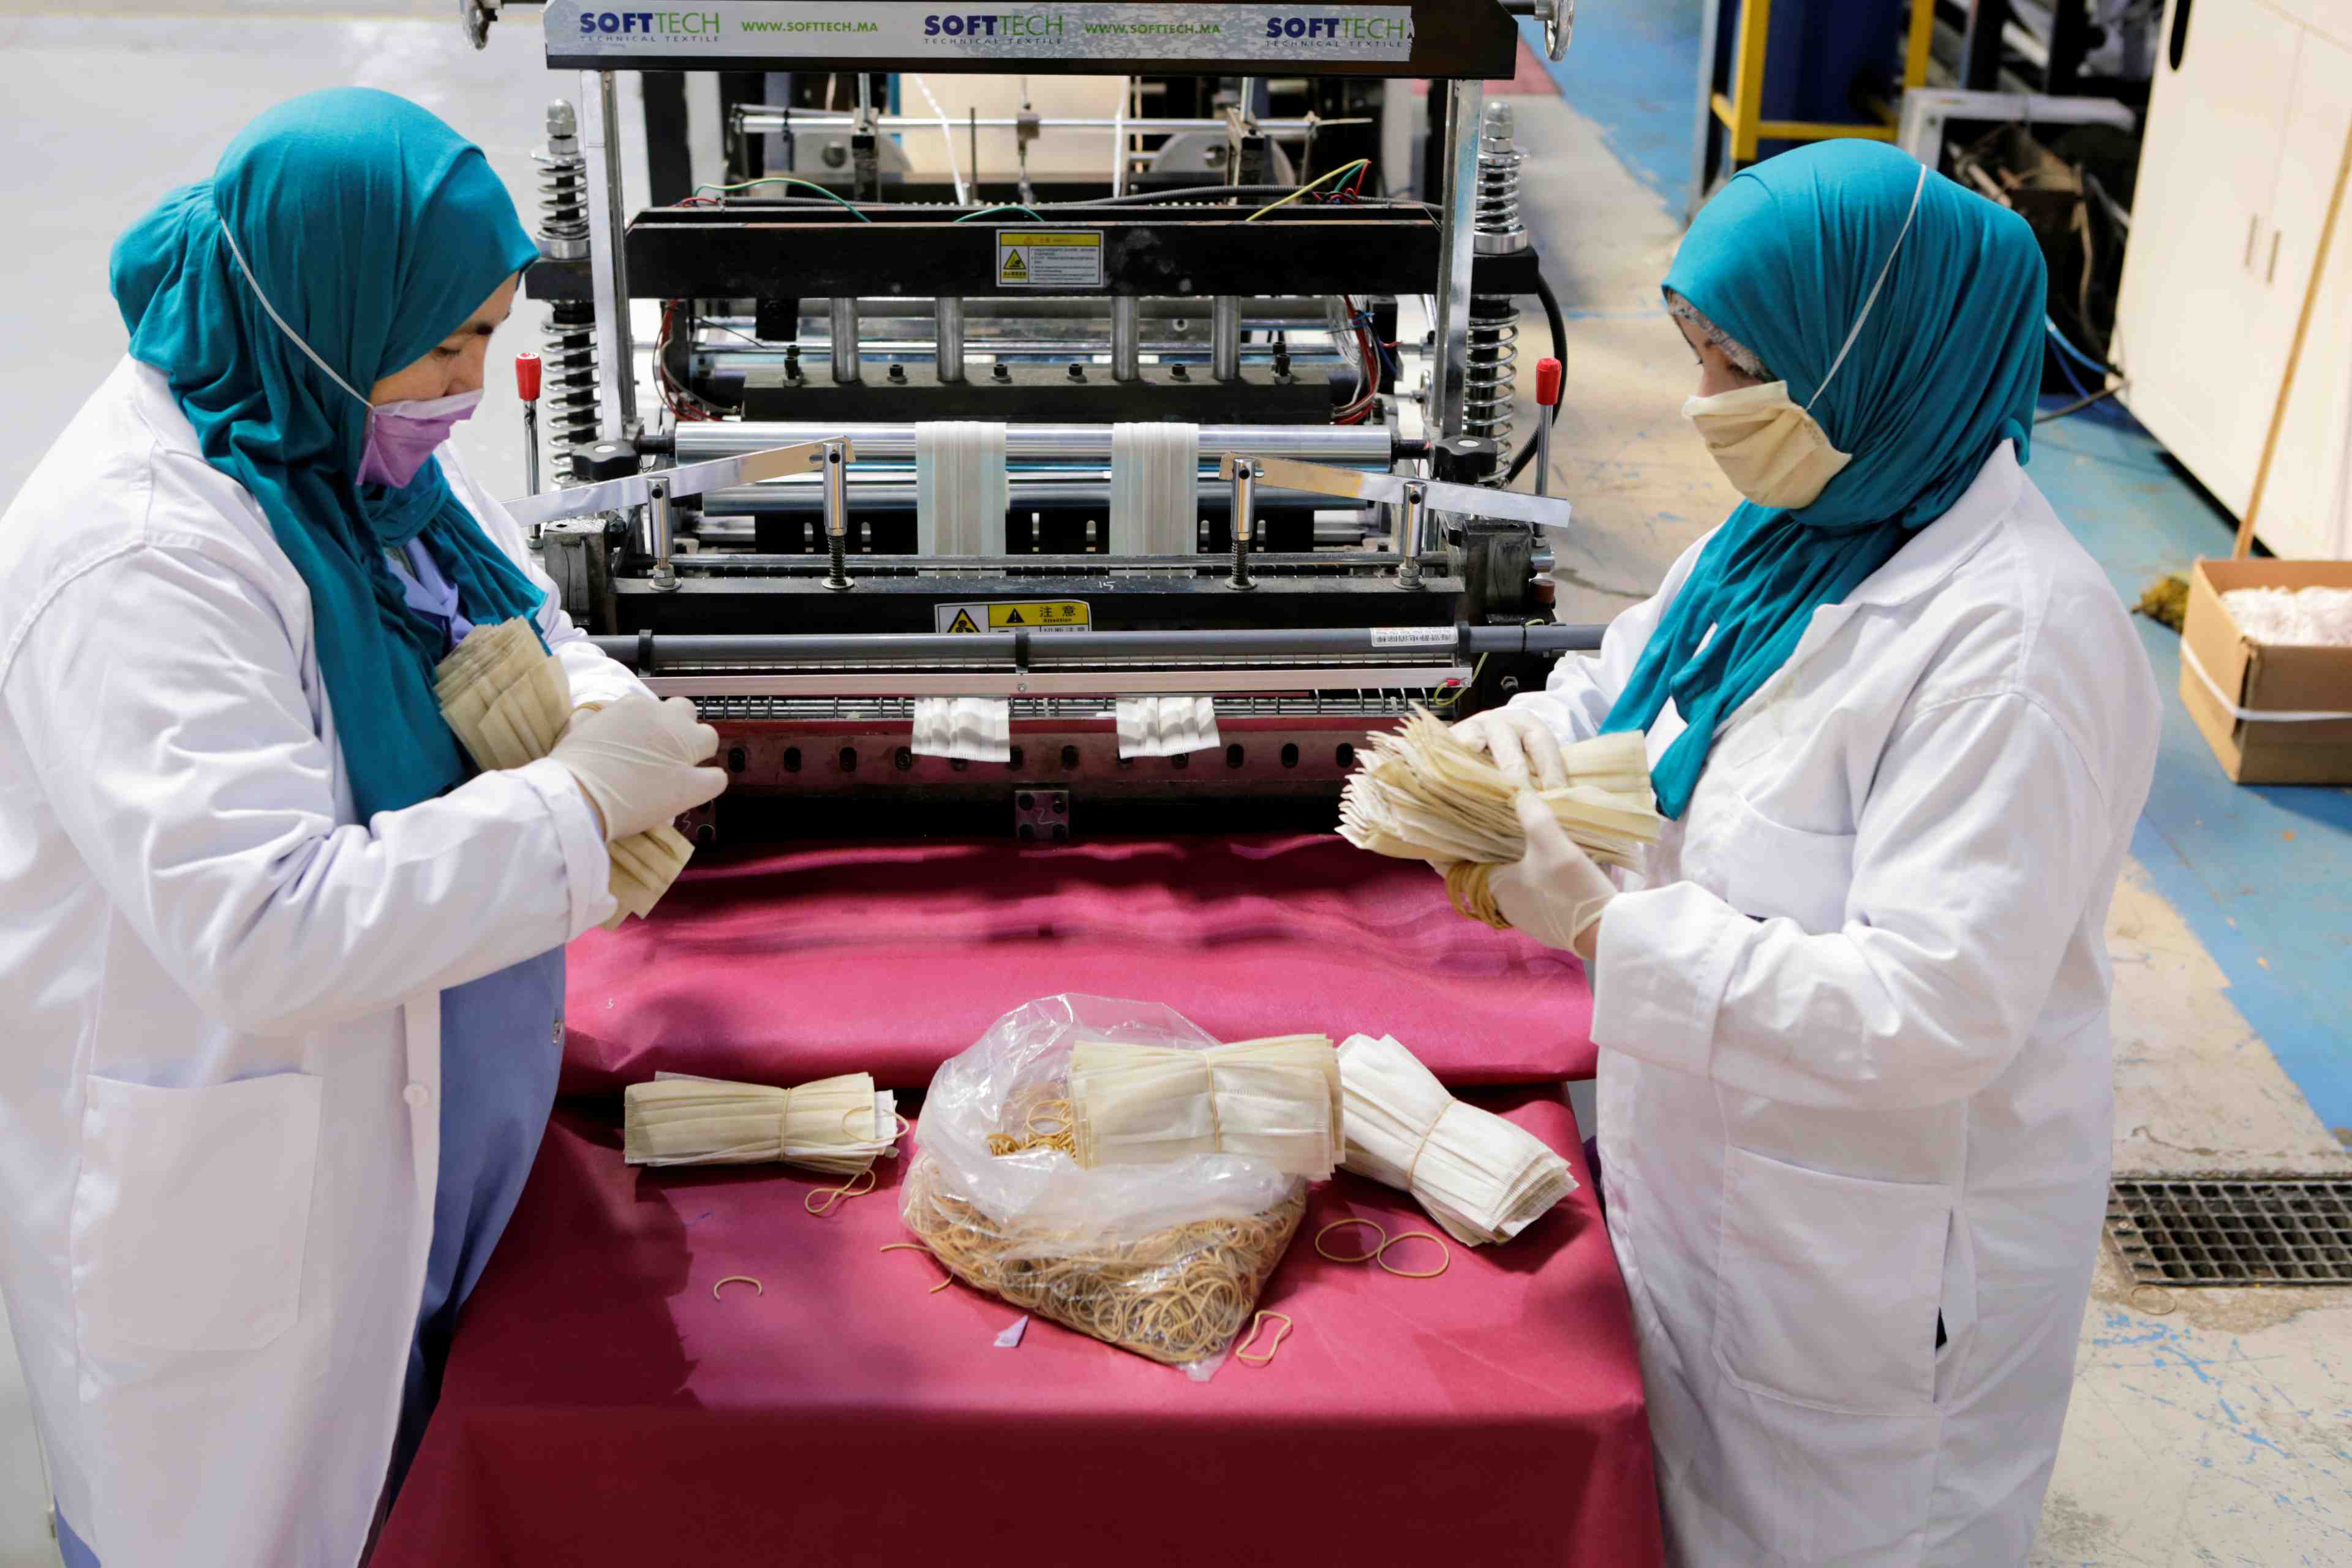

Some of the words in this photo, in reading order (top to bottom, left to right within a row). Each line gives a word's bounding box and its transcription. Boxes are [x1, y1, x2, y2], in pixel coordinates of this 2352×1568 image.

[579, 12, 720, 33] SOFTTECH
[741, 21, 878, 31] WWW.SOFTTECH.MA
[924, 15, 1063, 36] SOFTTECH
[1085, 24, 1221, 34] WWW.SOFTTECH.MA
[1266, 17, 1404, 39] SOFTTECH
[1039, 605, 1076, 617] 注意
